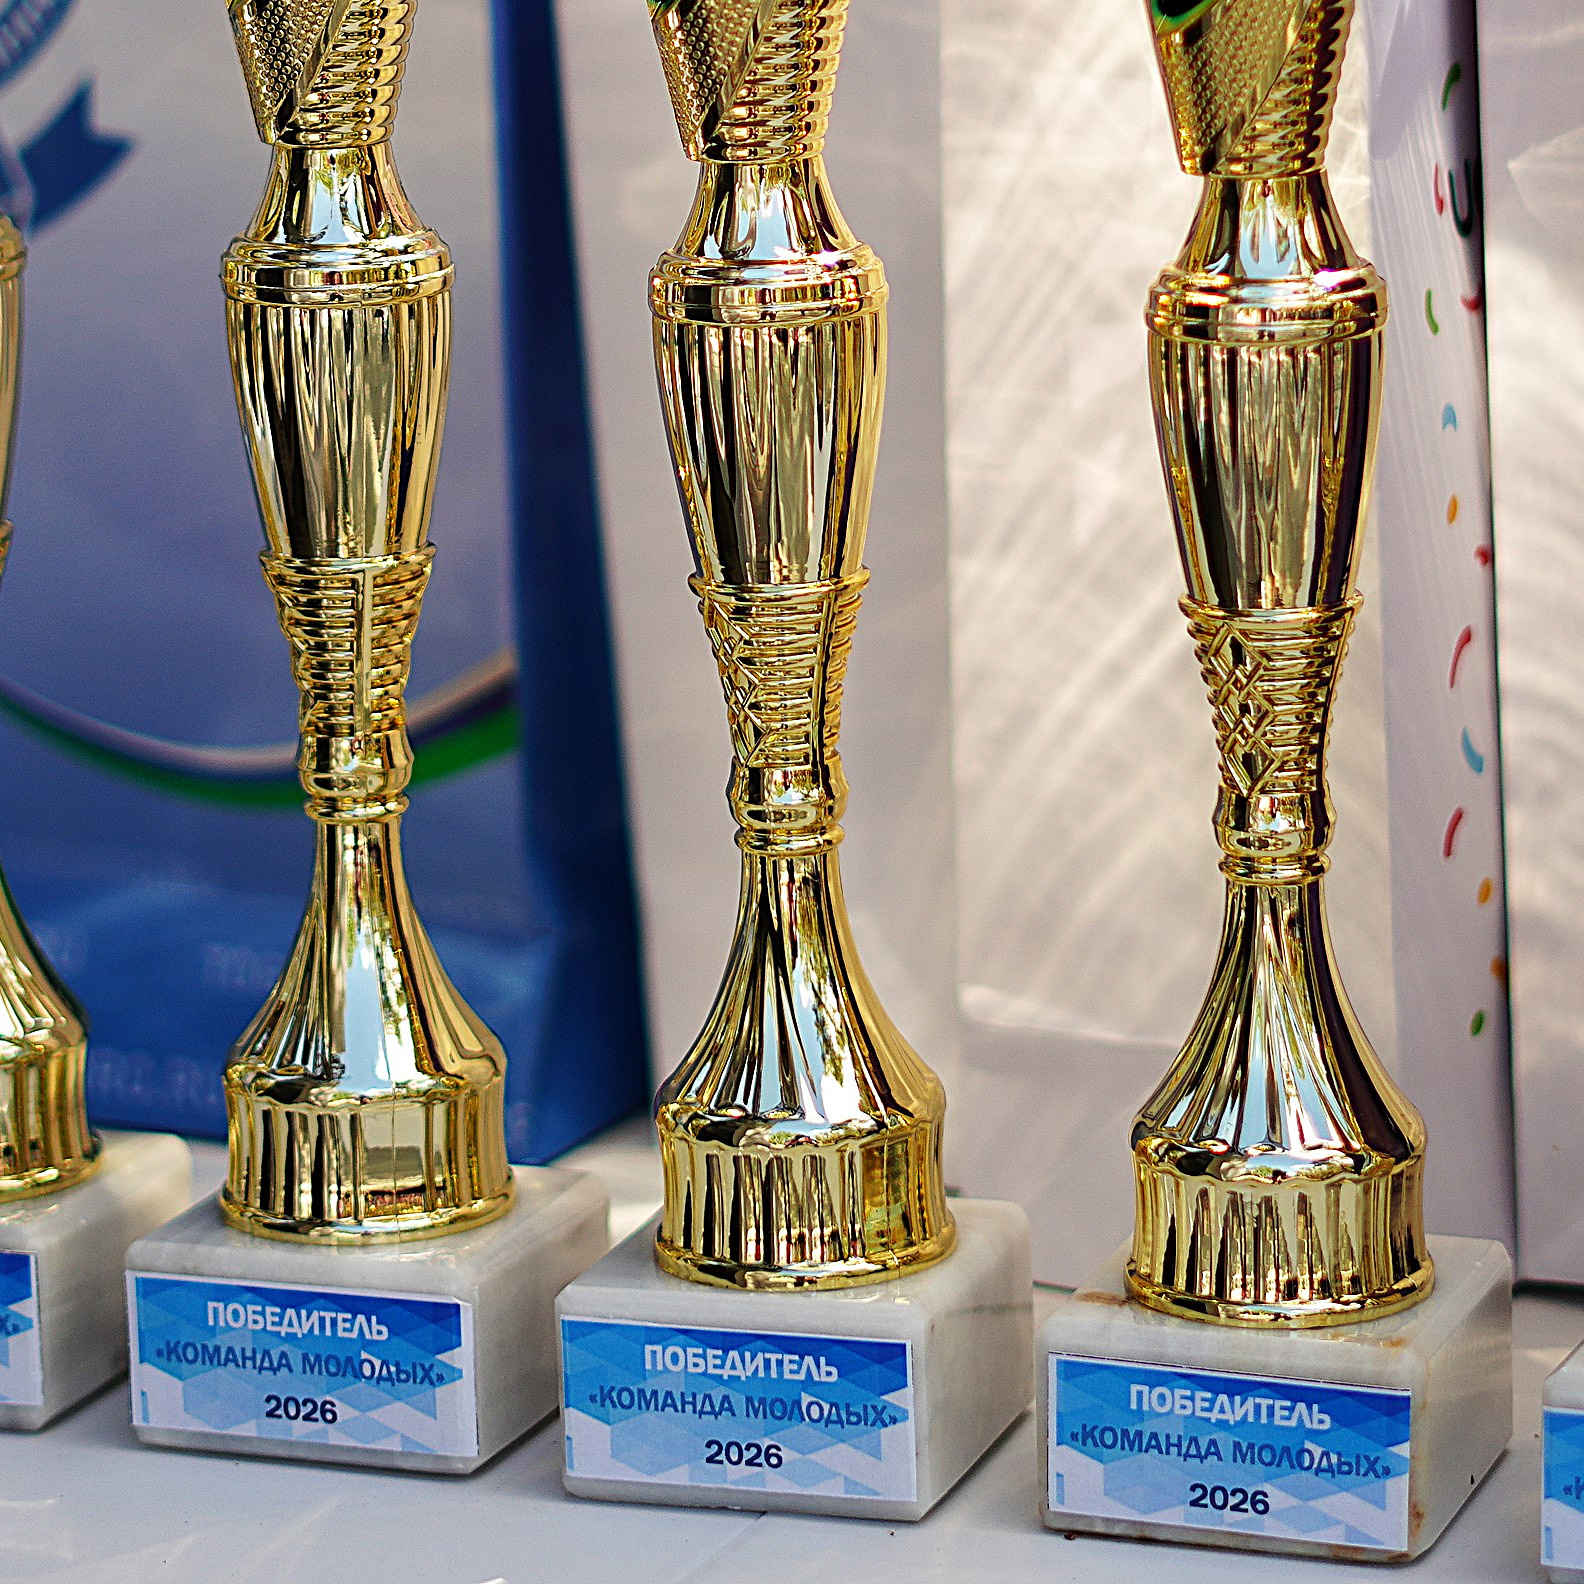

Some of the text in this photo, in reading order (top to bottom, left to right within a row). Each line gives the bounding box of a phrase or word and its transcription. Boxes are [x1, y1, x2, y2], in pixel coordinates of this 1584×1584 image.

[207, 1301, 389, 1341] ПОБЕДИТЕЛЬ
[156, 1340, 445, 1386] «КОМАНДА МОЛОДЫХ»
[644, 1344, 838, 1383] ПОБЕДИТЕЛЬ
[265, 1394, 337, 1424] 2026
[588, 1384, 898, 1428] «КОМАНДА МОЛОДЫХ»
[1129, 1384, 1331, 1430] ПОБЕДИТЕЛЬ
[705, 1439, 783, 1469] 2026
[1070, 1423, 1391, 1478] «КОМАНДА МОЛОДЫХ»
[1189, 1482, 1270, 1515] 2026
